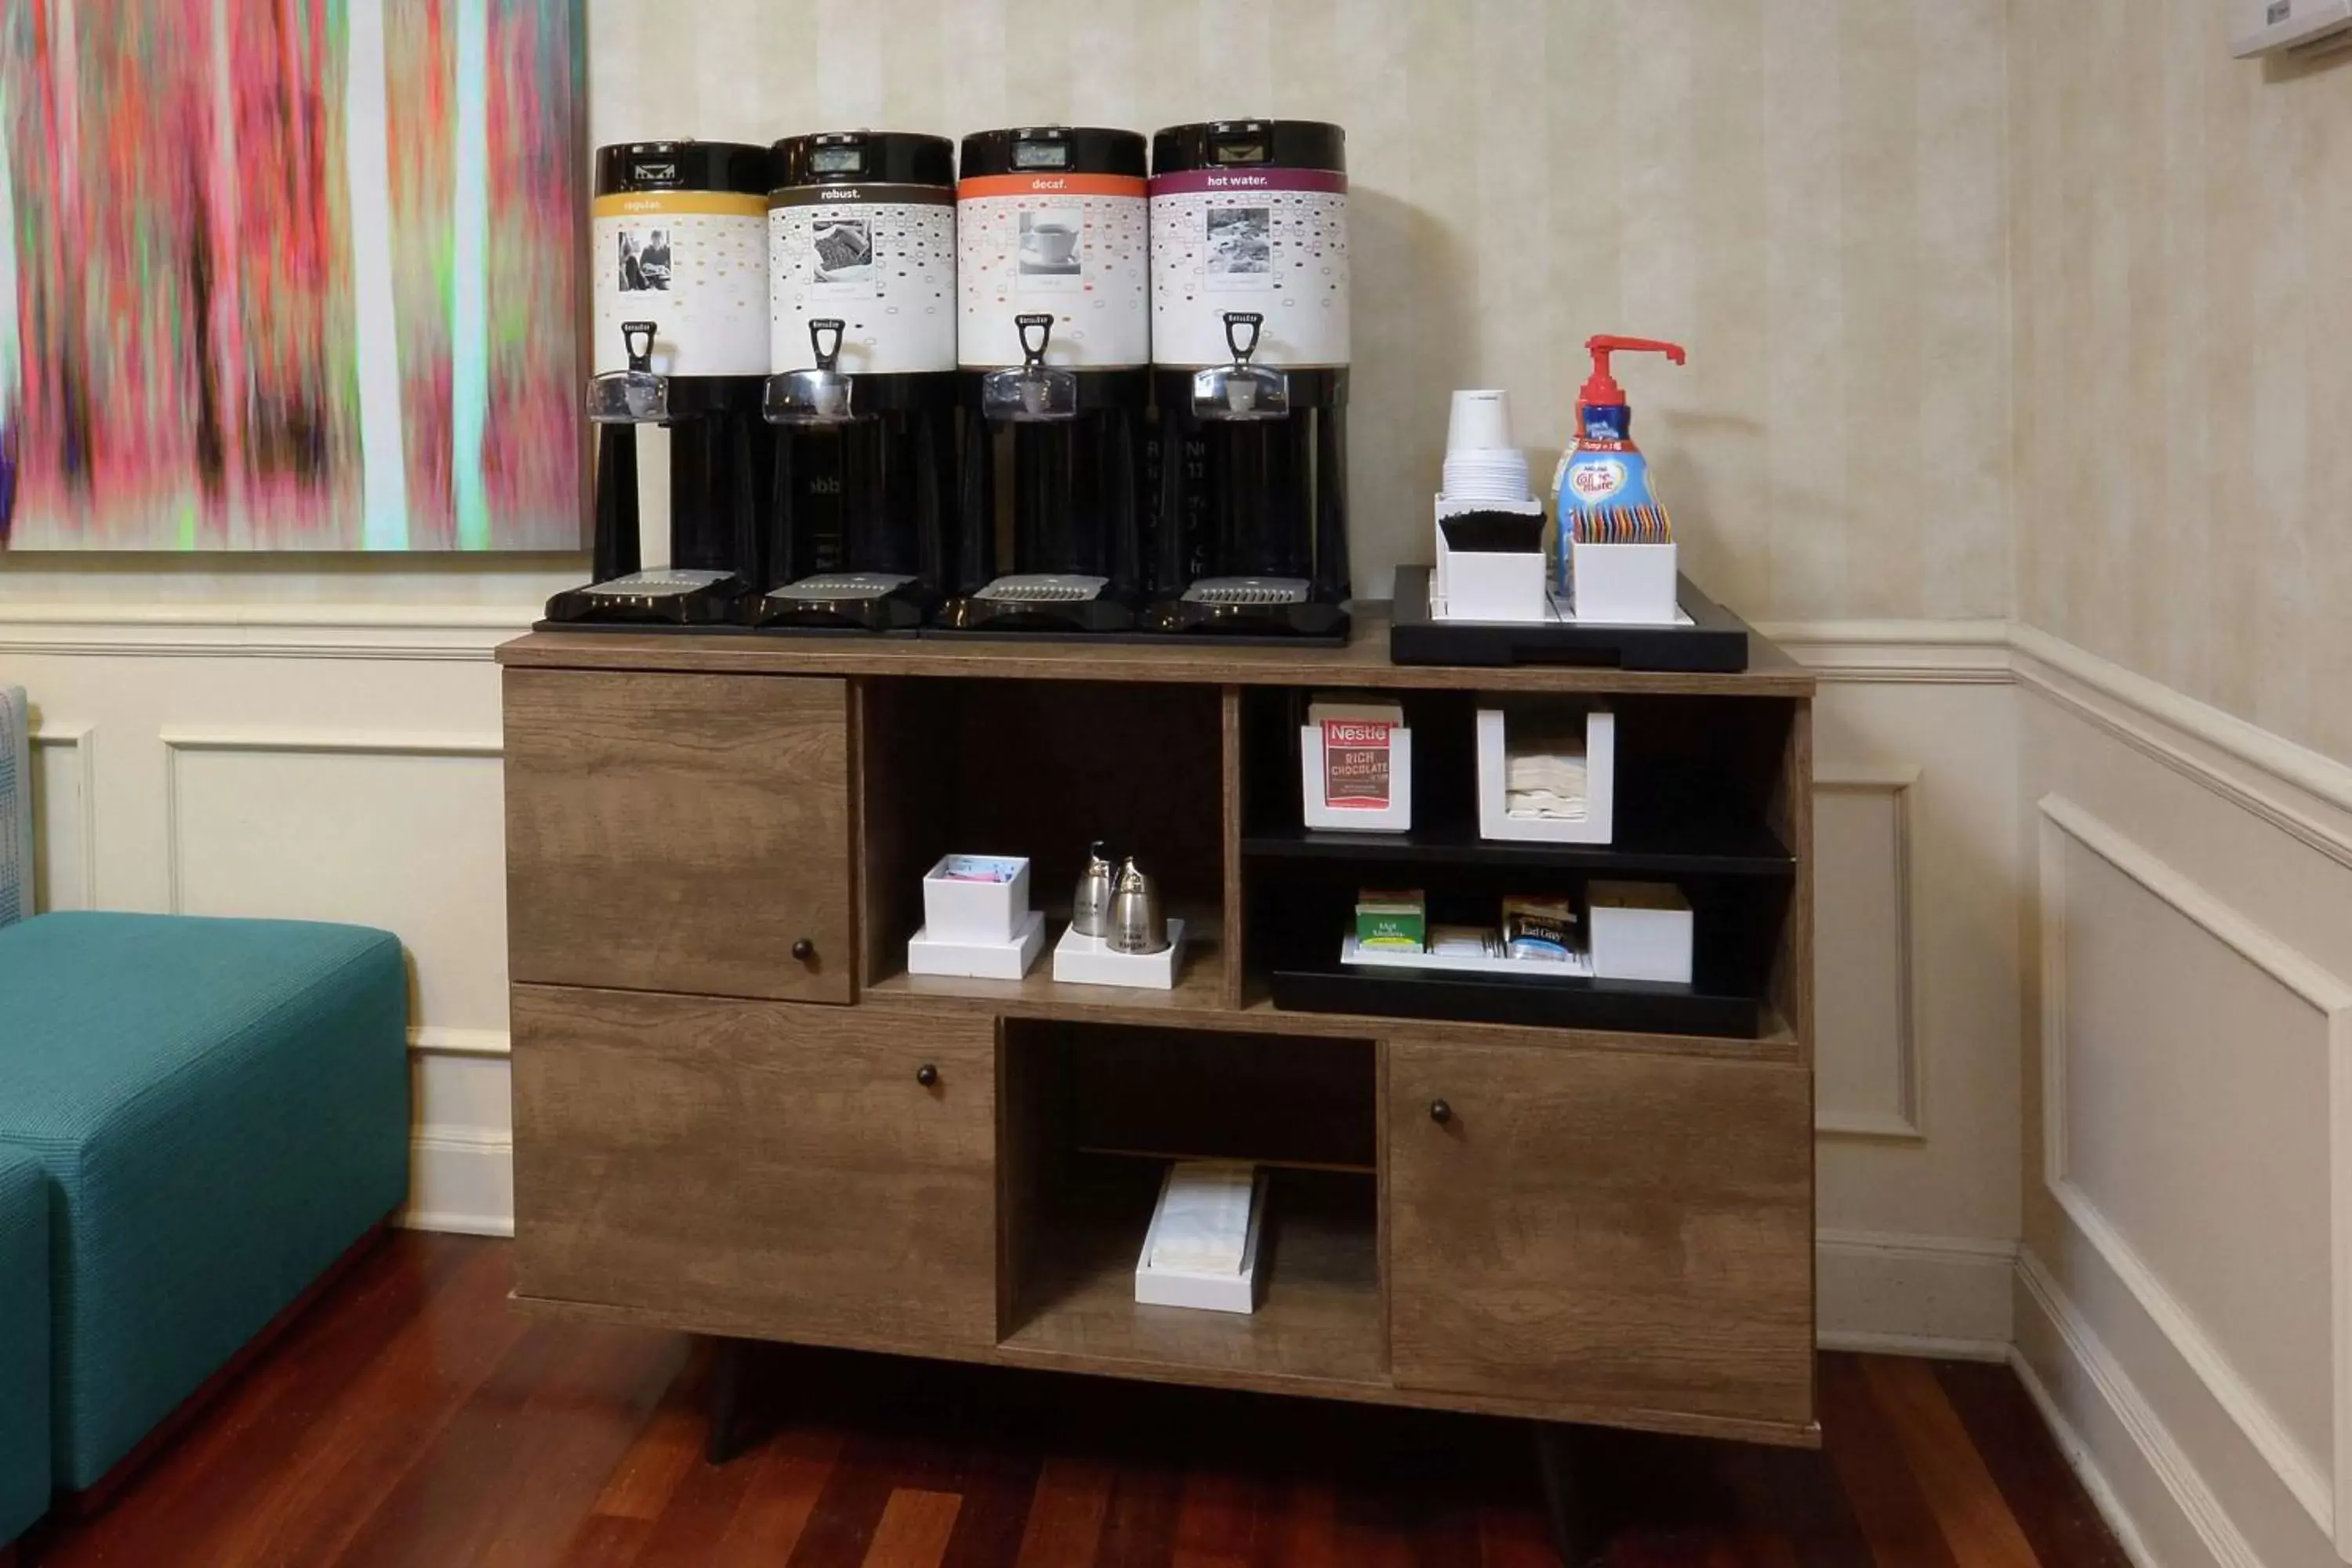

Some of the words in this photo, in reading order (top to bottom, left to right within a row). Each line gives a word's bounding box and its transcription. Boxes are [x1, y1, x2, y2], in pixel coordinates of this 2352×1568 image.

[1032, 178, 1067, 189] decaf.
[1207, 175, 1229, 186] hot
[1230, 175, 1268, 186] water.
[820, 188, 862, 199] robust.
[1345, 751, 1375, 765] RICH
[1330, 762, 1388, 776] CHOCOLATE
